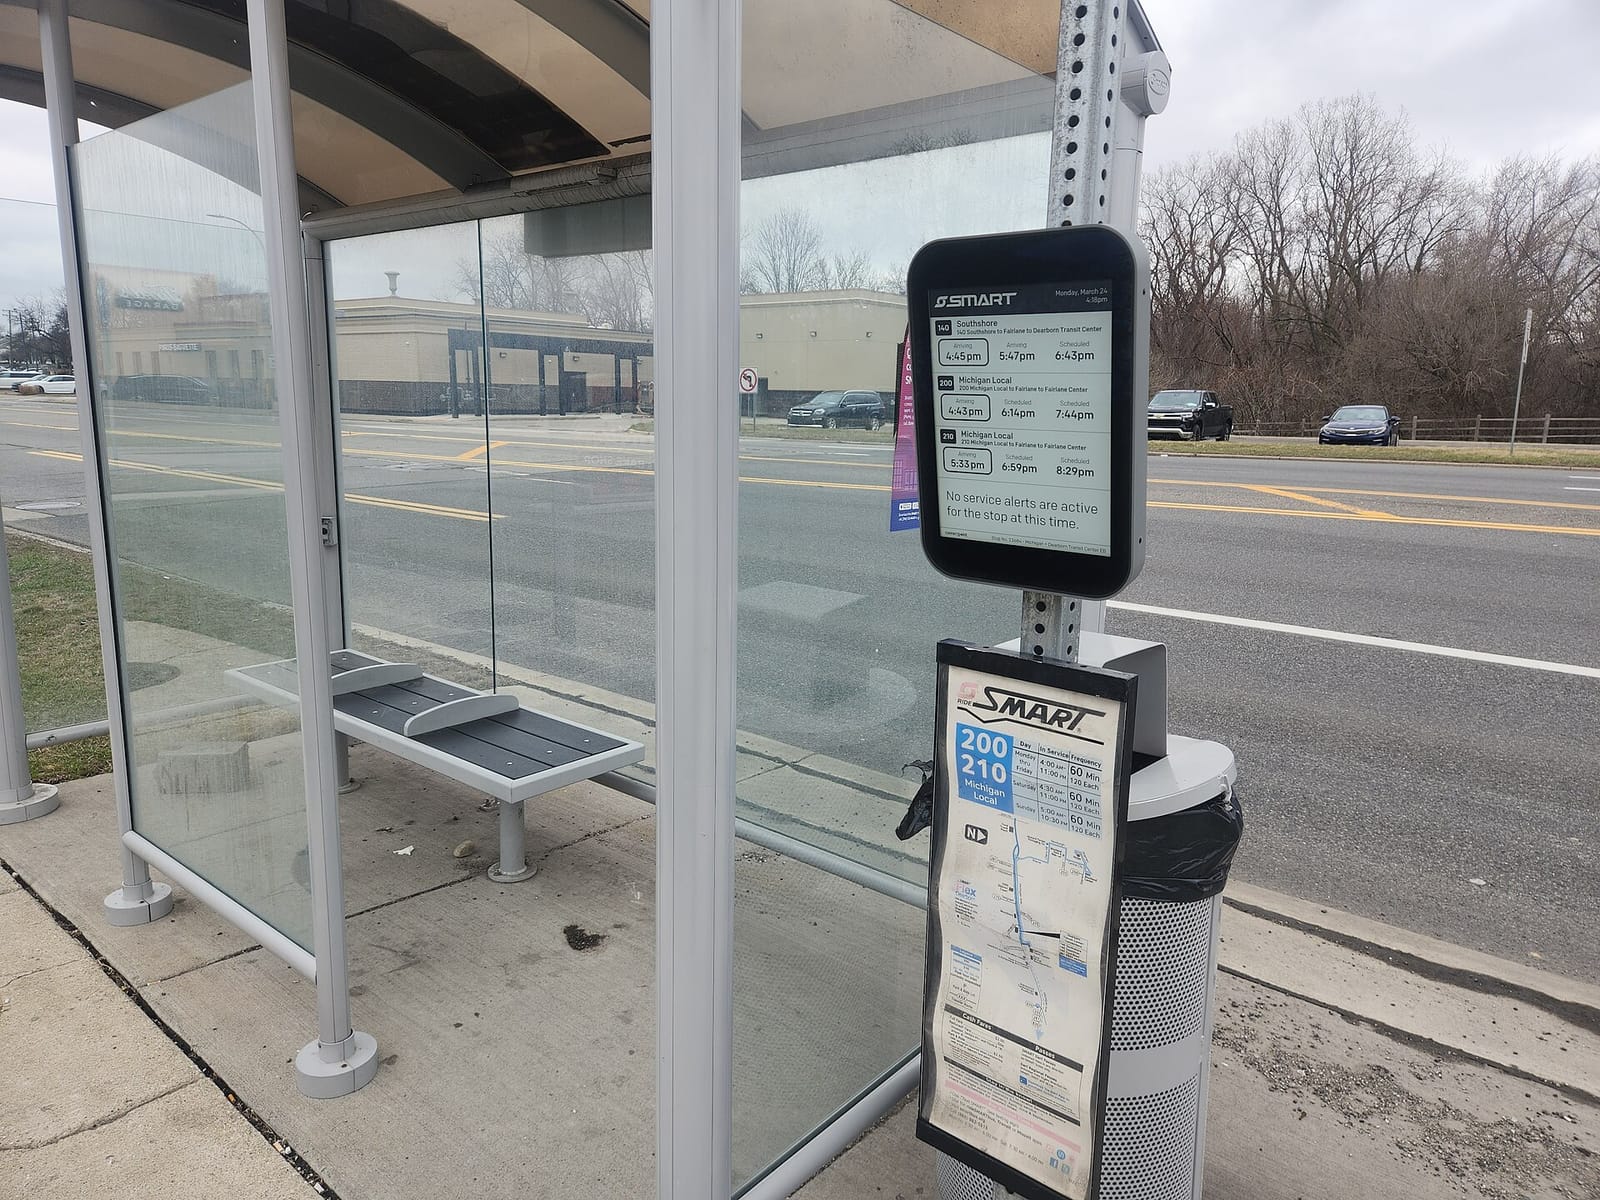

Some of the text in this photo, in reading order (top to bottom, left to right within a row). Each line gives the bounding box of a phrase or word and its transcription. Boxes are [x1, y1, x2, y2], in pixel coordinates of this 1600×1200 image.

[1055, 289, 1080, 297] Monday,
[1080, 288, 1099, 296] March
[945, 293, 1017, 308] SMART
[1086, 296, 1108, 304] 4:18pm
[937, 324, 950, 332] 140
[956, 320, 998, 328] Southshore
[1000, 351, 1035, 362] 5:47pm
[1055, 350, 1095, 362] 6:43pm
[959, 376, 991, 385] Michigan
[1001, 408, 1035, 419] 6:14pm
[1056, 409, 1094, 421] 7:44pm
[961, 431, 993, 440] Michigan
[1002, 463, 1037, 474] 6:59pm
[1056, 466, 1094, 478] 8:29pm
[946, 491, 1098, 515] No service alerts are active
[947, 506, 1079, 530] for the stop at this time.
[957, 686, 1106, 731] RIDE SMART
[961, 729, 1008, 758] 200
[1015, 750, 1036, 761] Monday
[1020, 741, 1031, 749] Day
[1047, 748, 1069, 758] Service
[1071, 754, 1102, 768] Frequency
[961, 754, 1007, 783] 210
[1016, 765, 1032, 775] Friday
[1040, 760, 1055, 768] 4:00
[1040, 767, 1059, 778] 11:00
[1070, 765, 1100, 782] 60 Min
[964, 779, 1006, 798] Michigan
[1013, 780, 1036, 792] Saturday
[1039, 784, 1054, 793] 4:30
[1070, 777, 1099, 790] 120 Each
[973, 792, 997, 806] Local
[1040, 792, 1058, 802] 11:00
[1069, 791, 1100, 807] 60 Min
[1016, 802, 1035, 813] Sunday
[1040, 806, 1055, 815] 5:00
[1070, 803, 1100, 815] 120 Each
[1070, 815, 1101, 830] 60 Min
[1071, 825, 1101, 839] 120 Each
[962, 1013, 992, 1031] Cash Fares
[1035, 1045, 1056, 1059] Passes
